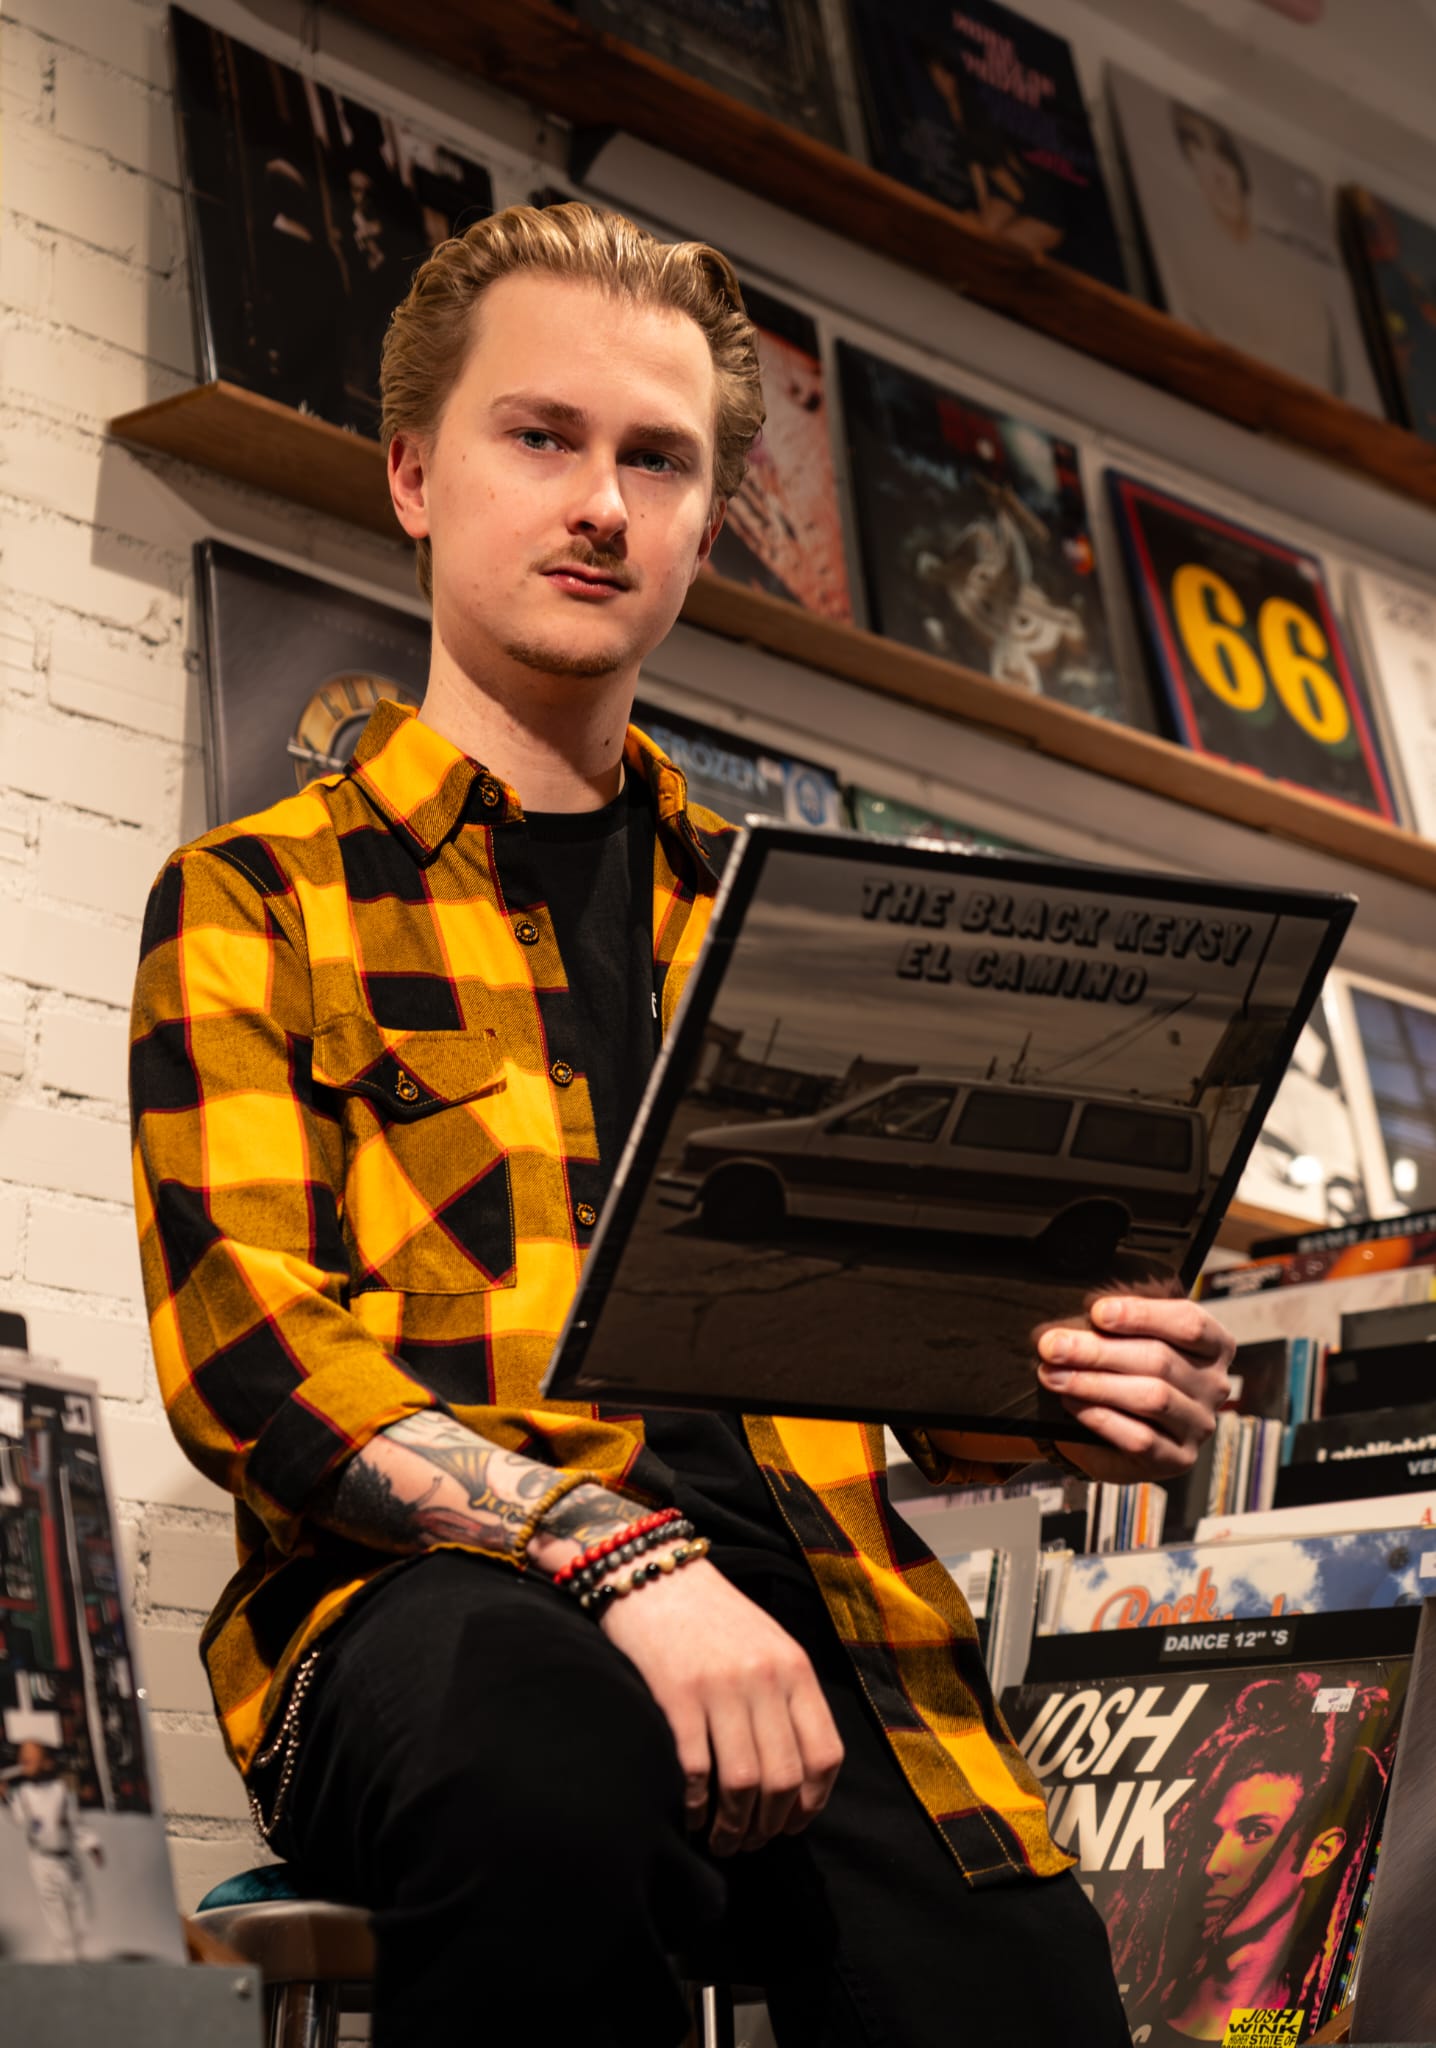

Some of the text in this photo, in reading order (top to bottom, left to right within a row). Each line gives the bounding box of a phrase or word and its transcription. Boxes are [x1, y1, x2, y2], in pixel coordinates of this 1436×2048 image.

[1172, 563, 1349, 744] 66
[862, 878, 1252, 968] THE BLACK KEYSY
[896, 939, 1149, 1006] EL CAMINO
[1164, 1632, 1230, 1652] DANCE
[1242, 2009, 1299, 2024] JOSH
[1229, 2023, 1299, 2035] WINK
[1249, 2034, 1283, 2046] STATE
[1284, 2035, 1298, 2047] OF
